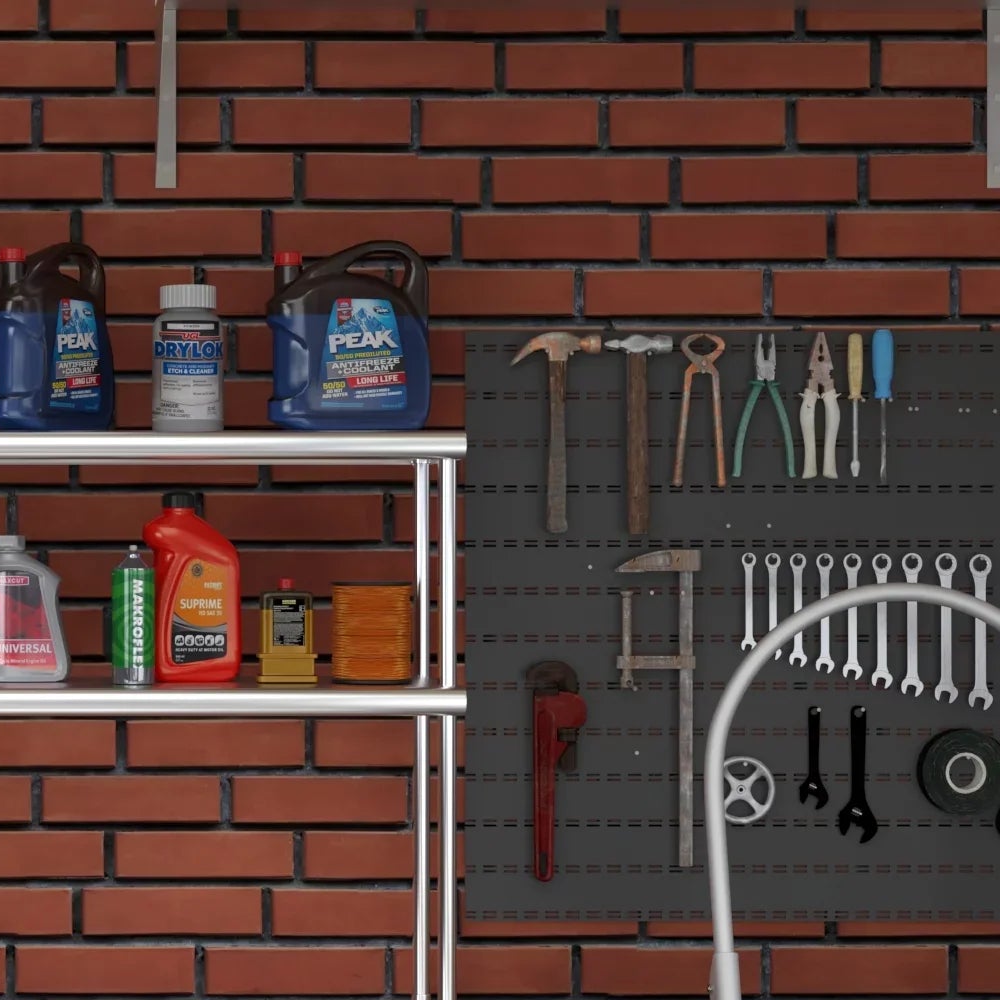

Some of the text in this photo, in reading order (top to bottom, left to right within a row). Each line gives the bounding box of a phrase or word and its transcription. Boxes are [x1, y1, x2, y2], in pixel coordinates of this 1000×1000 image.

[57, 332, 98, 353] PEAK
[328, 330, 399, 354] PEAK
[154, 340, 224, 358] DRYLOK
[58, 360, 98, 369] ANTIFREEZE
[332, 357, 400, 370] ANTIFREEZE
[356, 374, 399, 384] LONG LIFE
[322, 381, 346, 390] 50/50
[180, 598, 222, 609] SUPRIME
